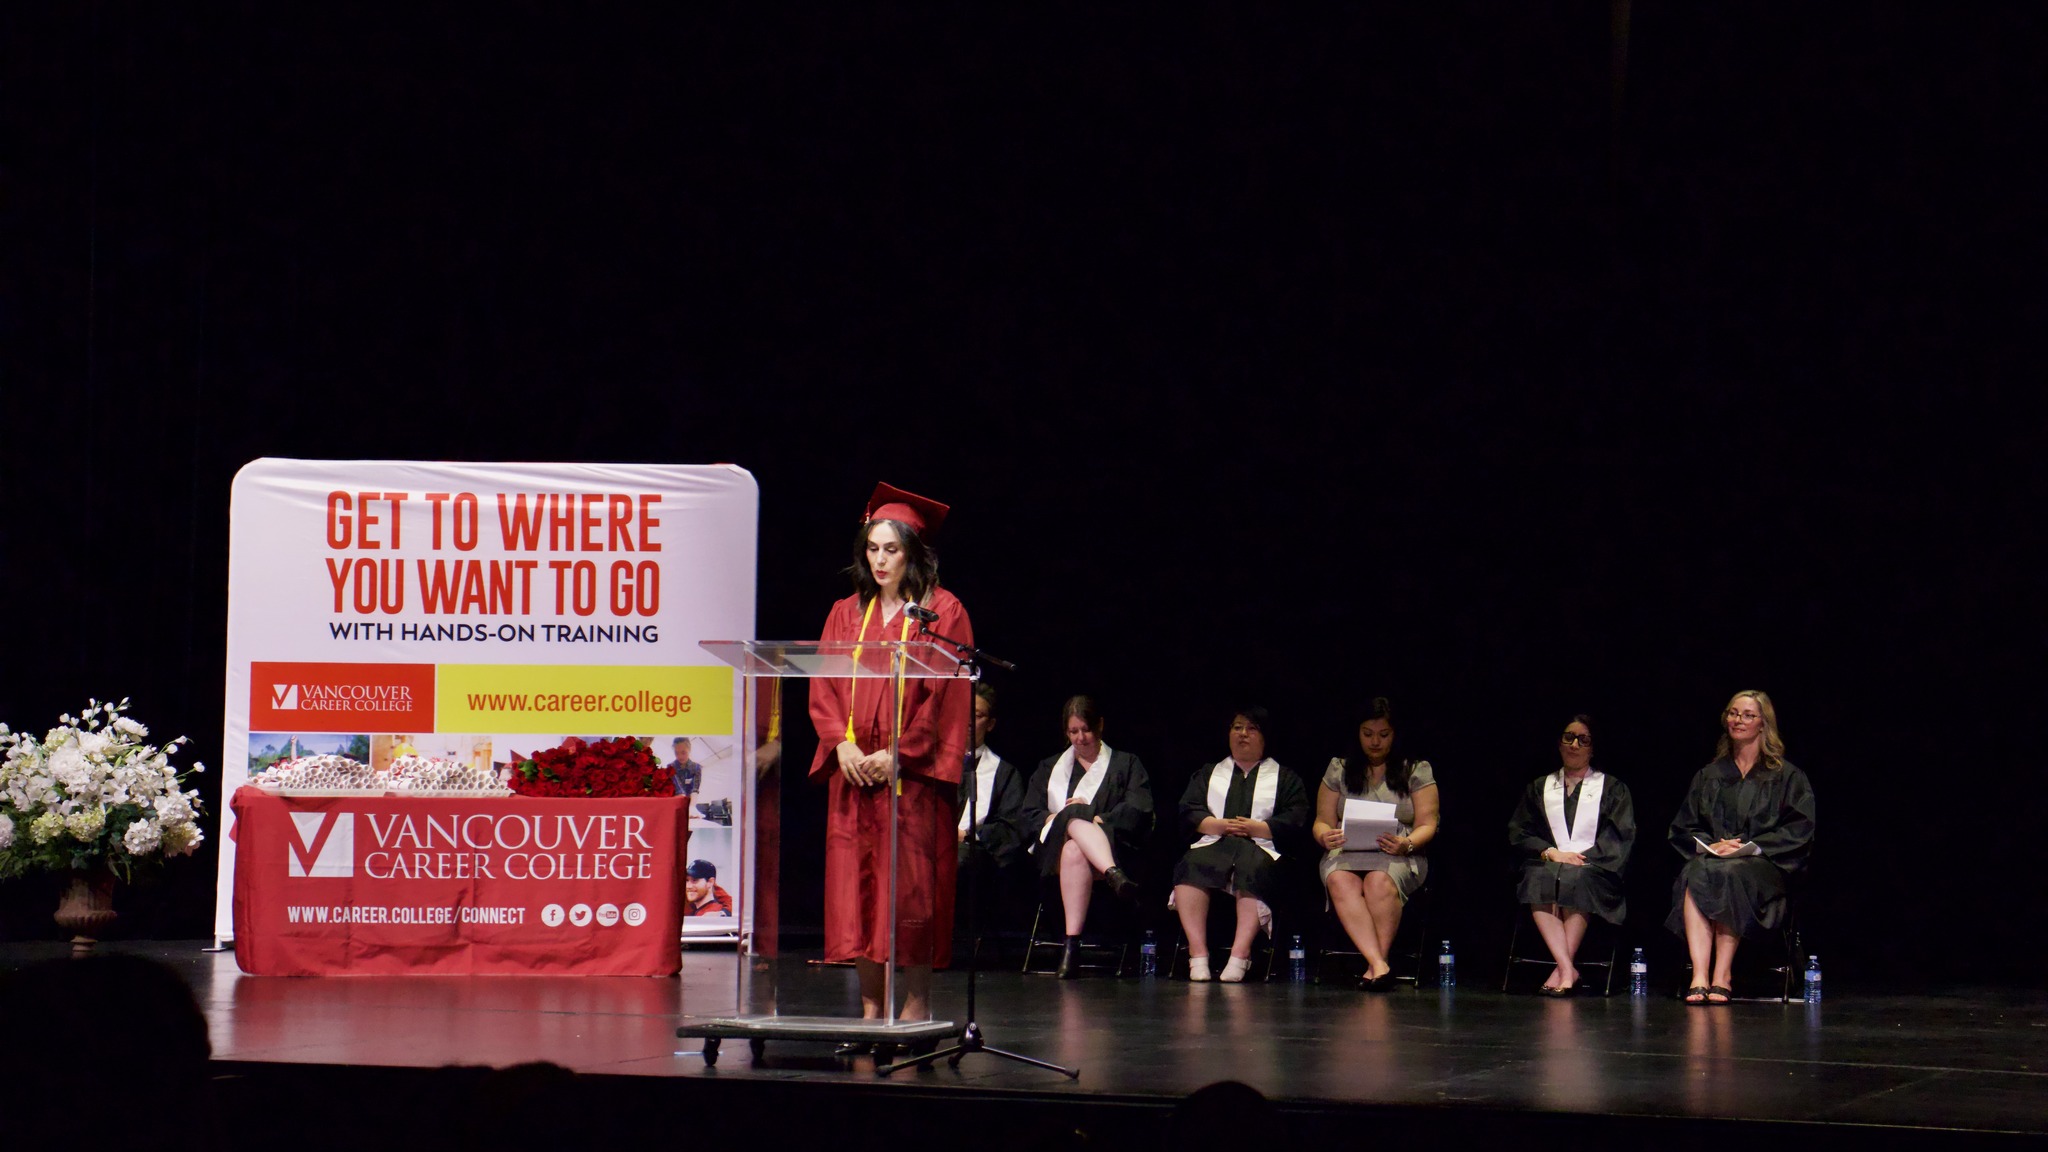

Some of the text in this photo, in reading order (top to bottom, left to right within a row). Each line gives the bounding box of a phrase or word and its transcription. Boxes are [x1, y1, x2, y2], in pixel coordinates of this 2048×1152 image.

[326, 490, 662, 552] GET TO WHERE
[325, 557, 660, 616] YOU WANT TO GO
[329, 622, 659, 643] WITH HANDS-ON TRAINING
[302, 684, 412, 700] VANCOUVER
[467, 690, 692, 717] www.career.college
[301, 700, 413, 712] CAREER COLLEGE
[364, 813, 654, 850] VANCOUVER
[364, 852, 652, 880] CAREER COLLEGE
[287, 906, 526, 925] WWW.CAREER.COLLEGE/CONNECT
